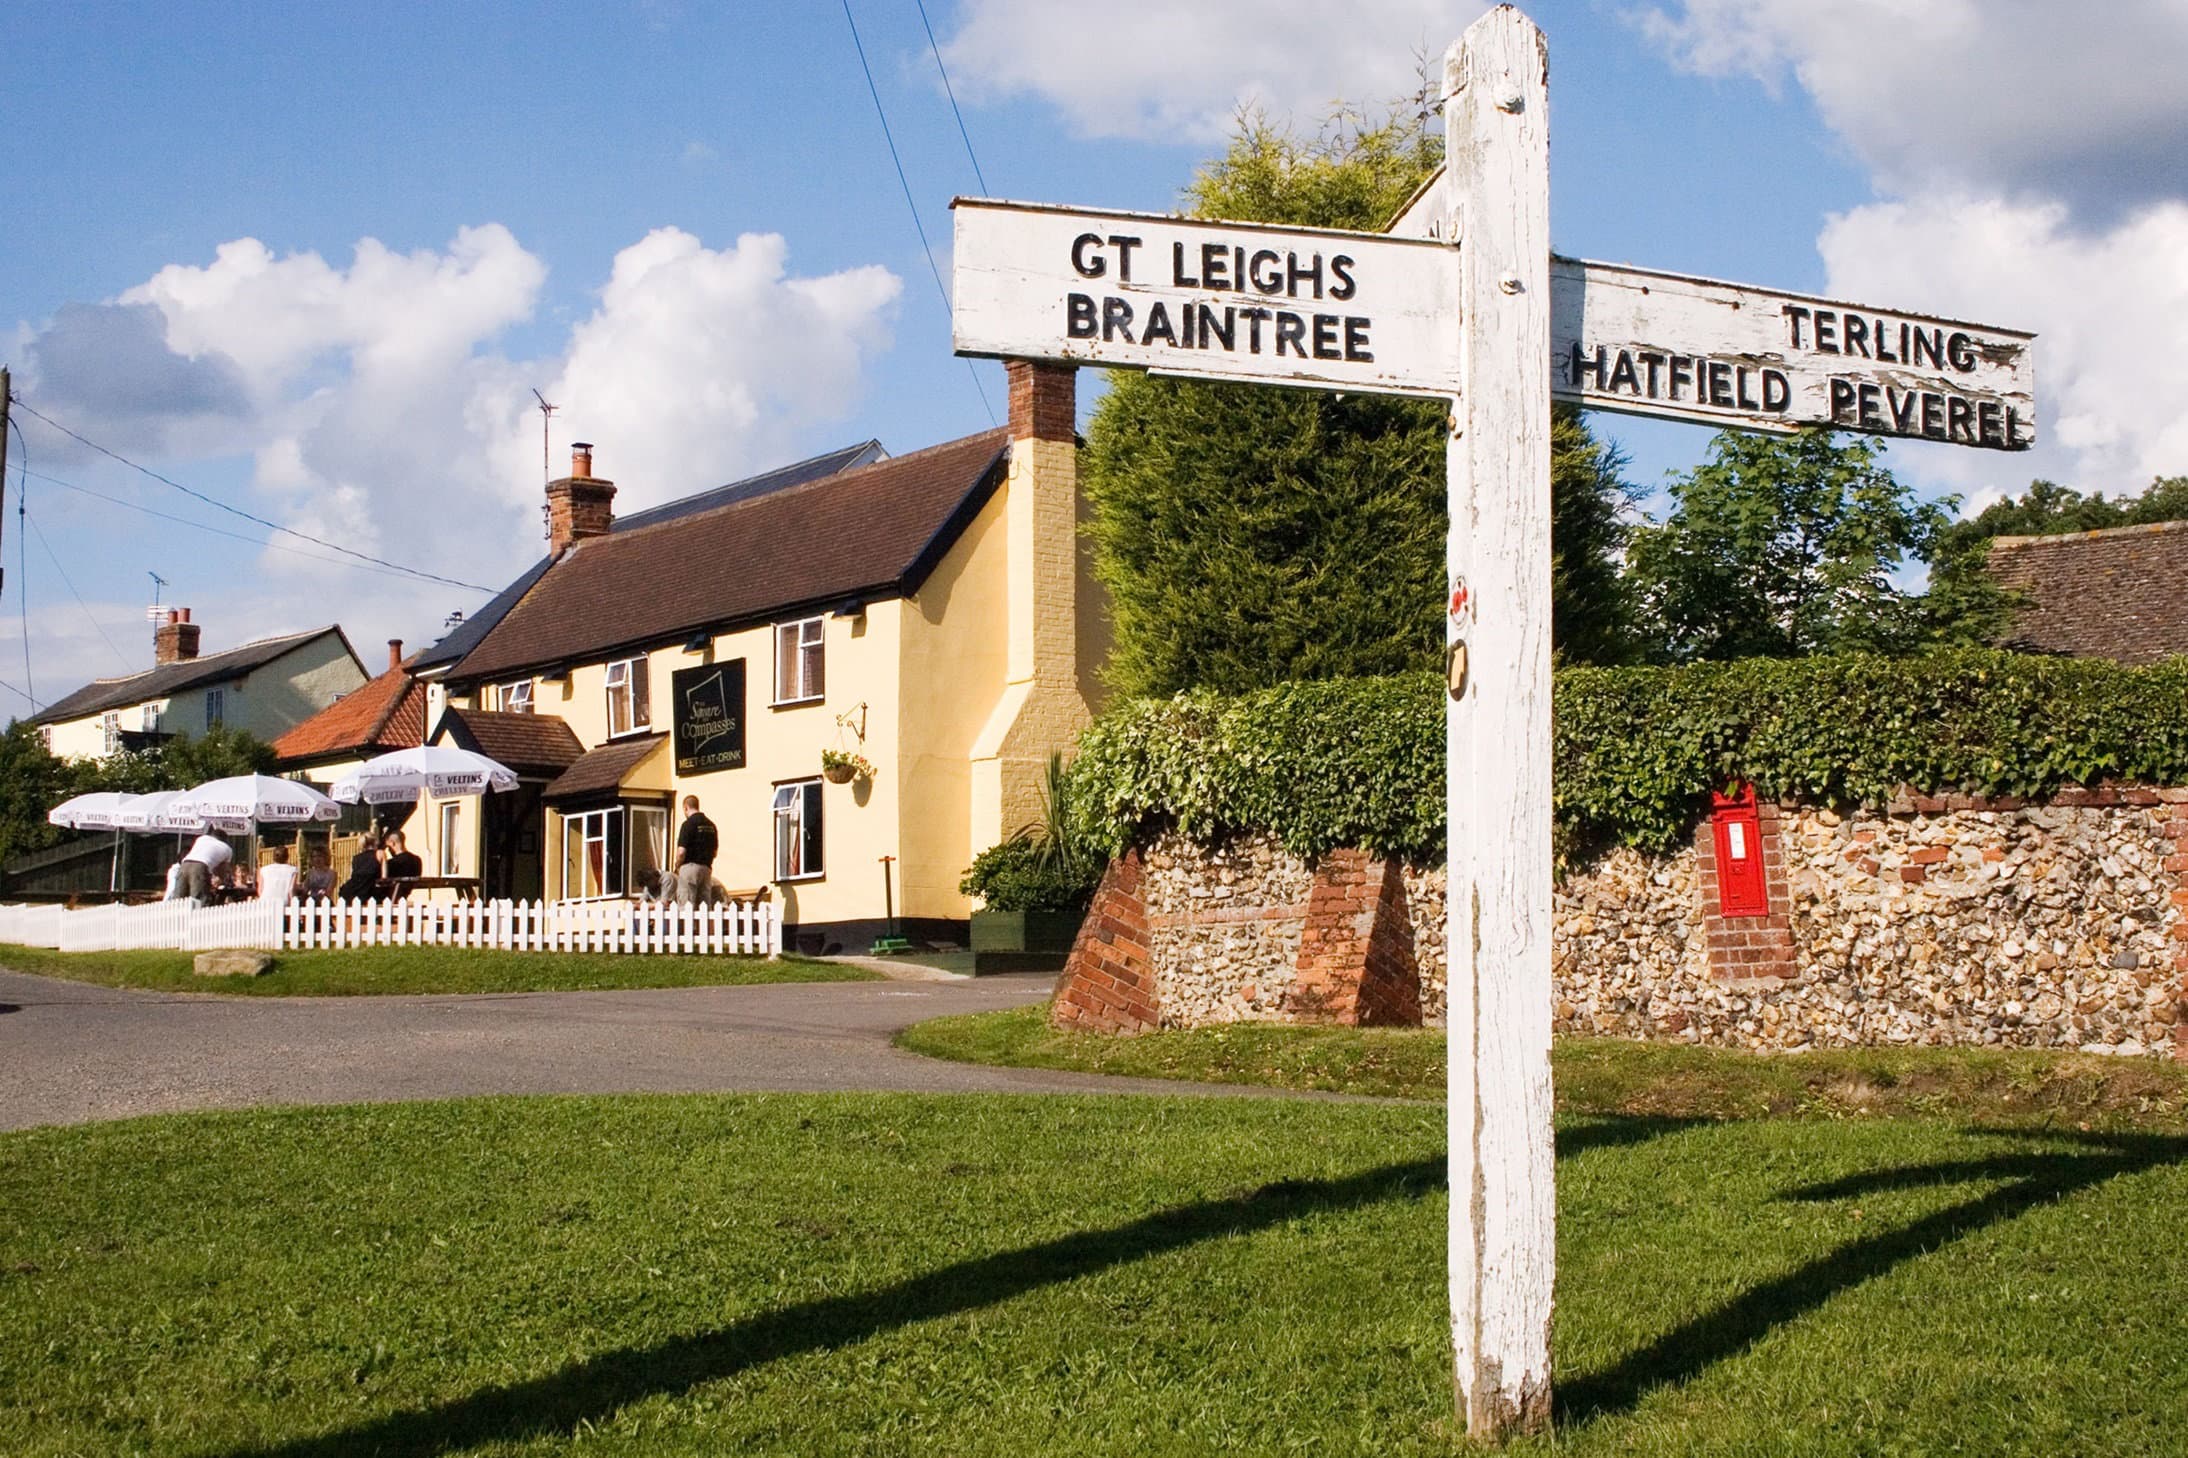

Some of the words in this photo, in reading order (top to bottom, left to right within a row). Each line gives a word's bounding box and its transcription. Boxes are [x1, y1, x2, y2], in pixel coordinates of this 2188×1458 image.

[1071, 233, 1142, 282] GT
[1173, 241, 1356, 300] LEIGHS
[1067, 292, 1375, 363] BRAINTREE
[1782, 305, 1977, 373] TERLING
[1572, 341, 1790, 412] HATFIELD
[1828, 376, 2030, 450] PEVEREL
[681, 718, 736, 739] Compasses
[447, 774, 482, 784] VELTINS
[216, 804, 249, 814] VELTINS
[276, 805, 310, 815] VELTINS
